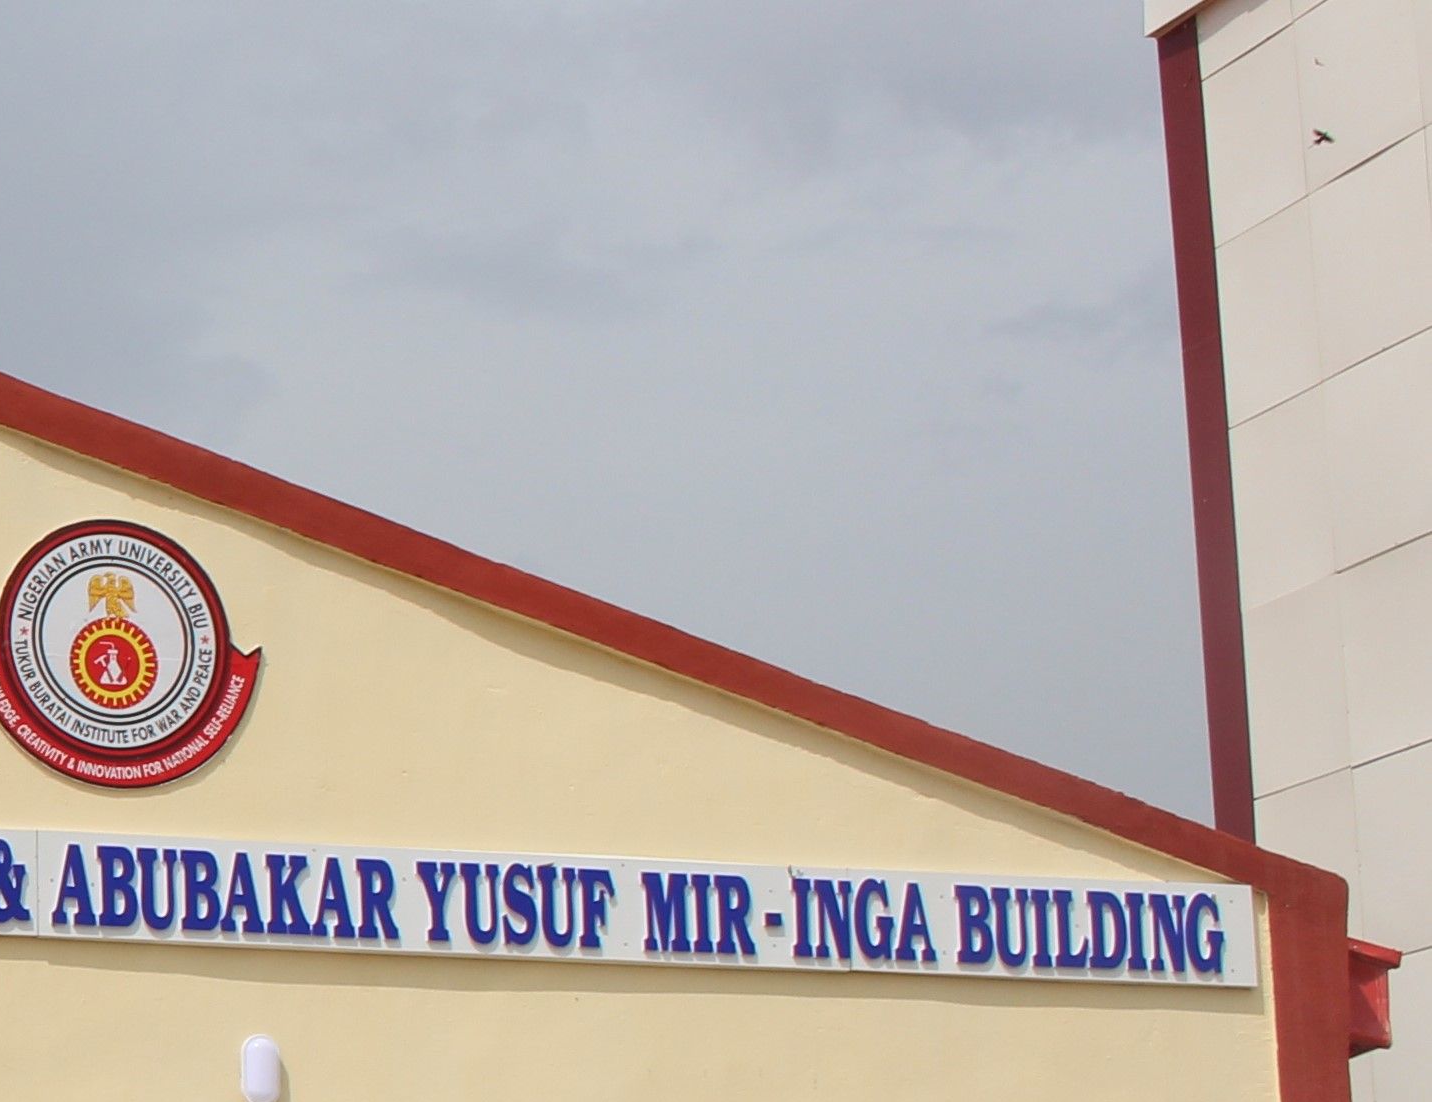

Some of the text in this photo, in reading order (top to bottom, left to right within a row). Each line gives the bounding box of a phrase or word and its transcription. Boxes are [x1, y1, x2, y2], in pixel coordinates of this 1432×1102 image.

[18, 539, 207, 629] NIGERIAN ARMY UNIVERSITY BIU
[15, 640, 212, 744] TUKUR BURATAI INSTITUTE FOR WAR AND PEACE
[17, 724, 67, 766] CREATIVITY
[67, 759, 75, 770] &
[77, 761, 141, 779] INNOVATION
[143, 760, 163, 777] FOR
[164, 735, 208, 771] NATIONAL
[205, 674, 245, 739] SELF-RELIANCE
[51, 843, 400, 941] ABUBAKAR
[415, 860, 615, 950] YUSUF
[953, 884, 1225, 974] BUILDING
